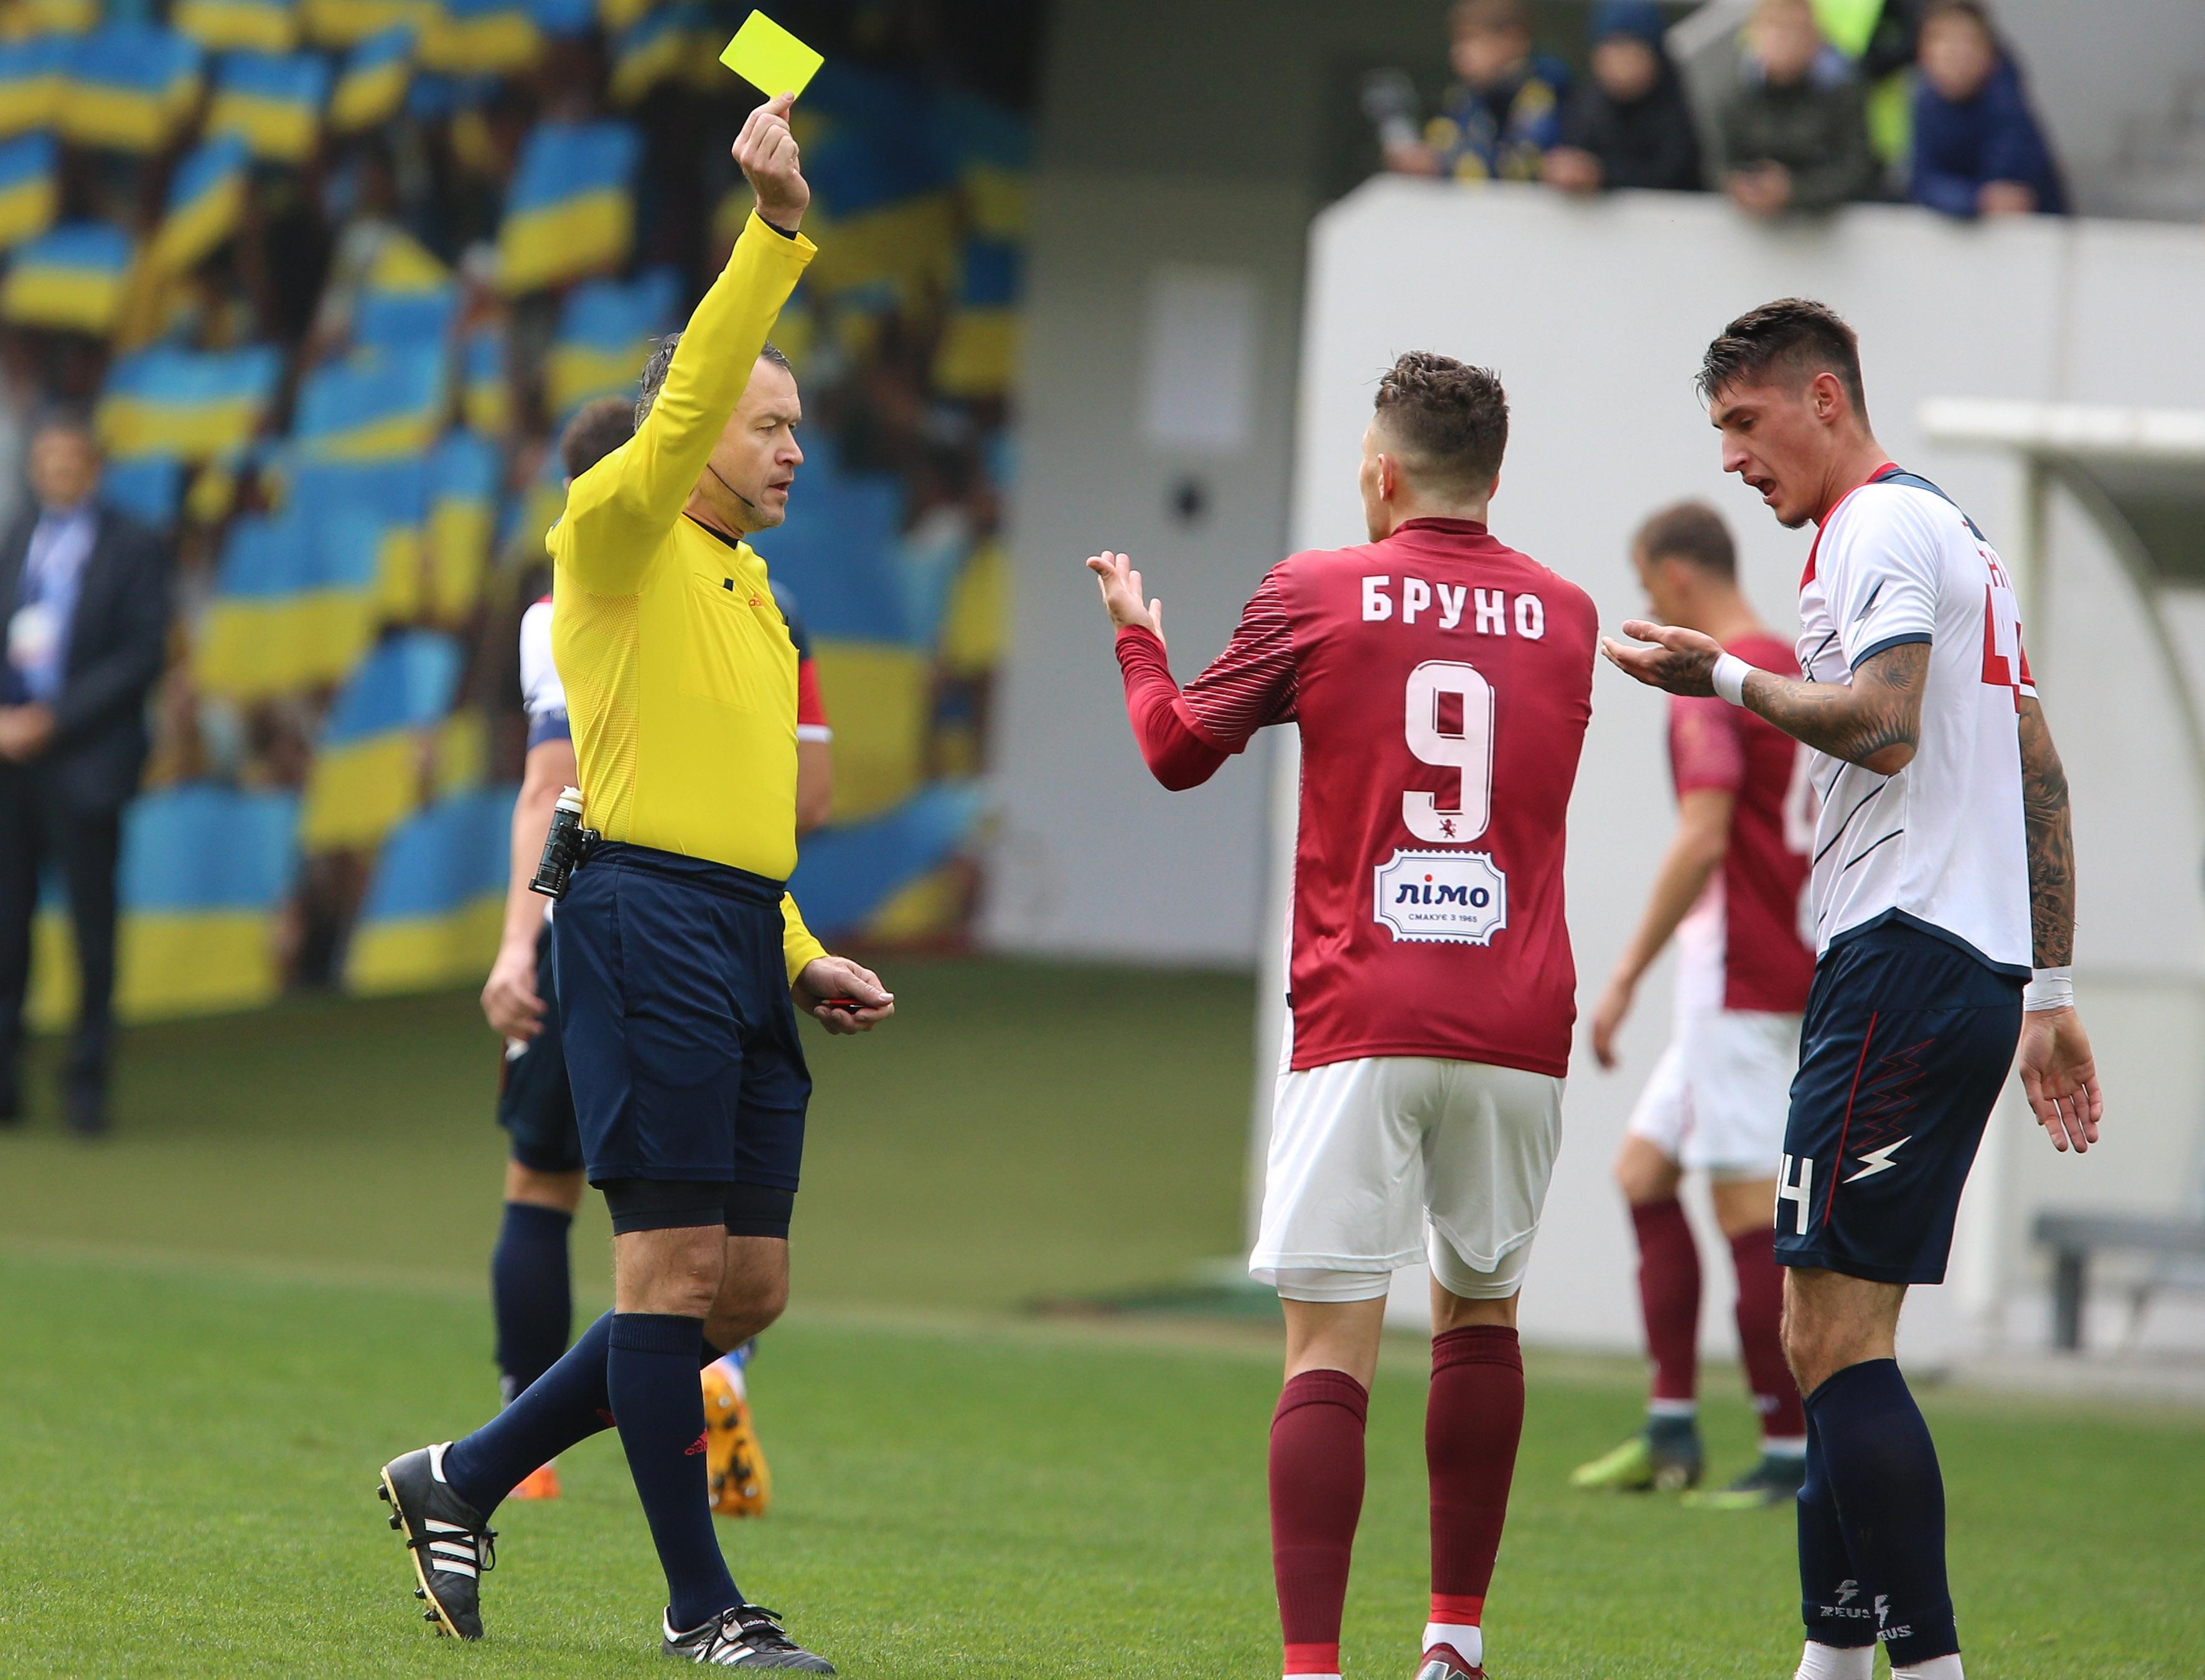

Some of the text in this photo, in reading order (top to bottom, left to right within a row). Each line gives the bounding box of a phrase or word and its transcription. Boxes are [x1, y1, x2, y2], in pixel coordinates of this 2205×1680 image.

[1361, 576, 1545, 640] БРУНО
[1402, 660, 1494, 843] 9
[1395, 874, 1489, 908] лімо
[1876, 1625, 1914, 1641] EUS
